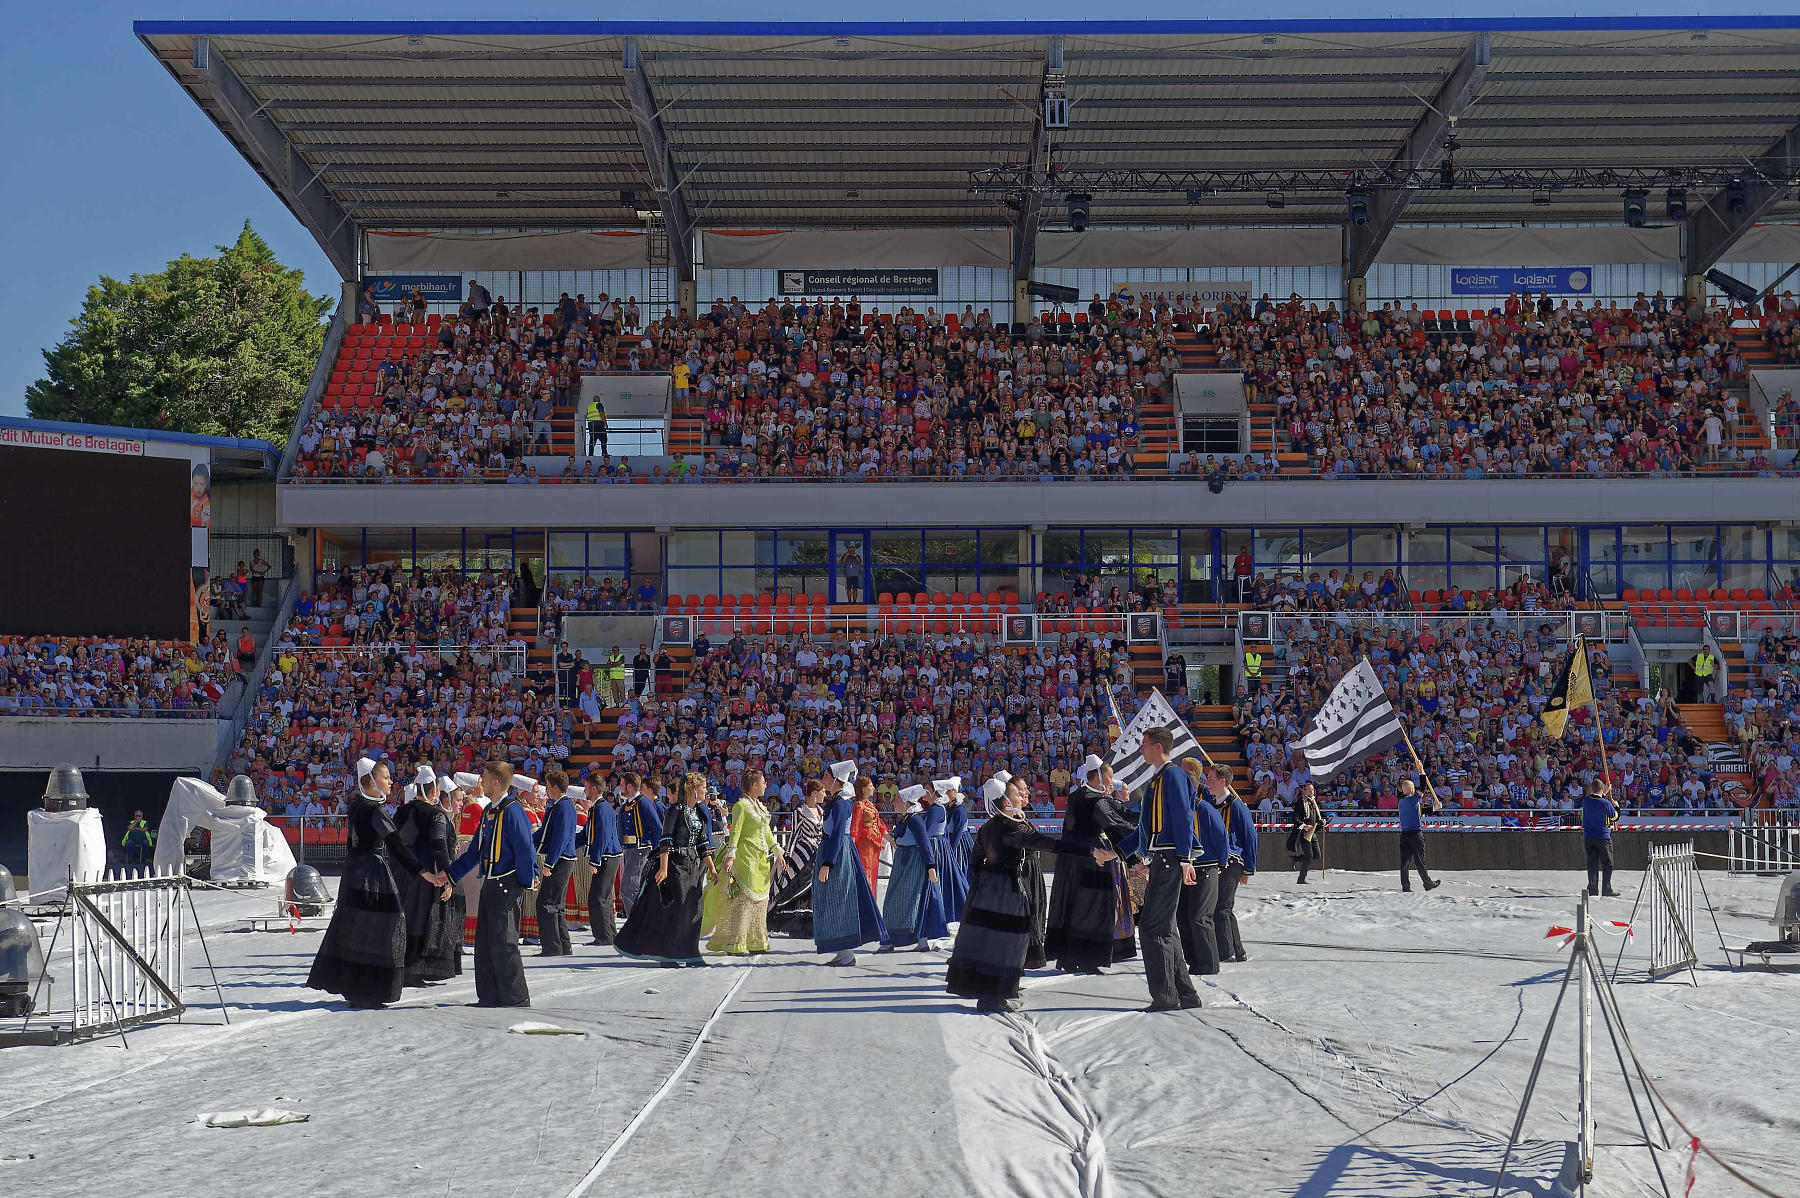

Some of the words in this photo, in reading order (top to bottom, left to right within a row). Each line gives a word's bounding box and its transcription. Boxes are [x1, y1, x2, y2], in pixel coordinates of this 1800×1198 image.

[808, 275, 841, 284] Conseil
[842, 275, 878, 286] régional
[880, 275, 891, 284] de
[893, 275, 932, 285] Bretagne
[401, 282, 457, 291] morbihan.fr
[1139, 291, 1175, 301] VILE
[0, 429, 18, 443] dit
[21, 430, 64, 446] Mutuel
[66, 435, 82, 448] de
[84, 436, 141, 454] Bretagne
[1715, 764, 1748, 773] LORIENT
